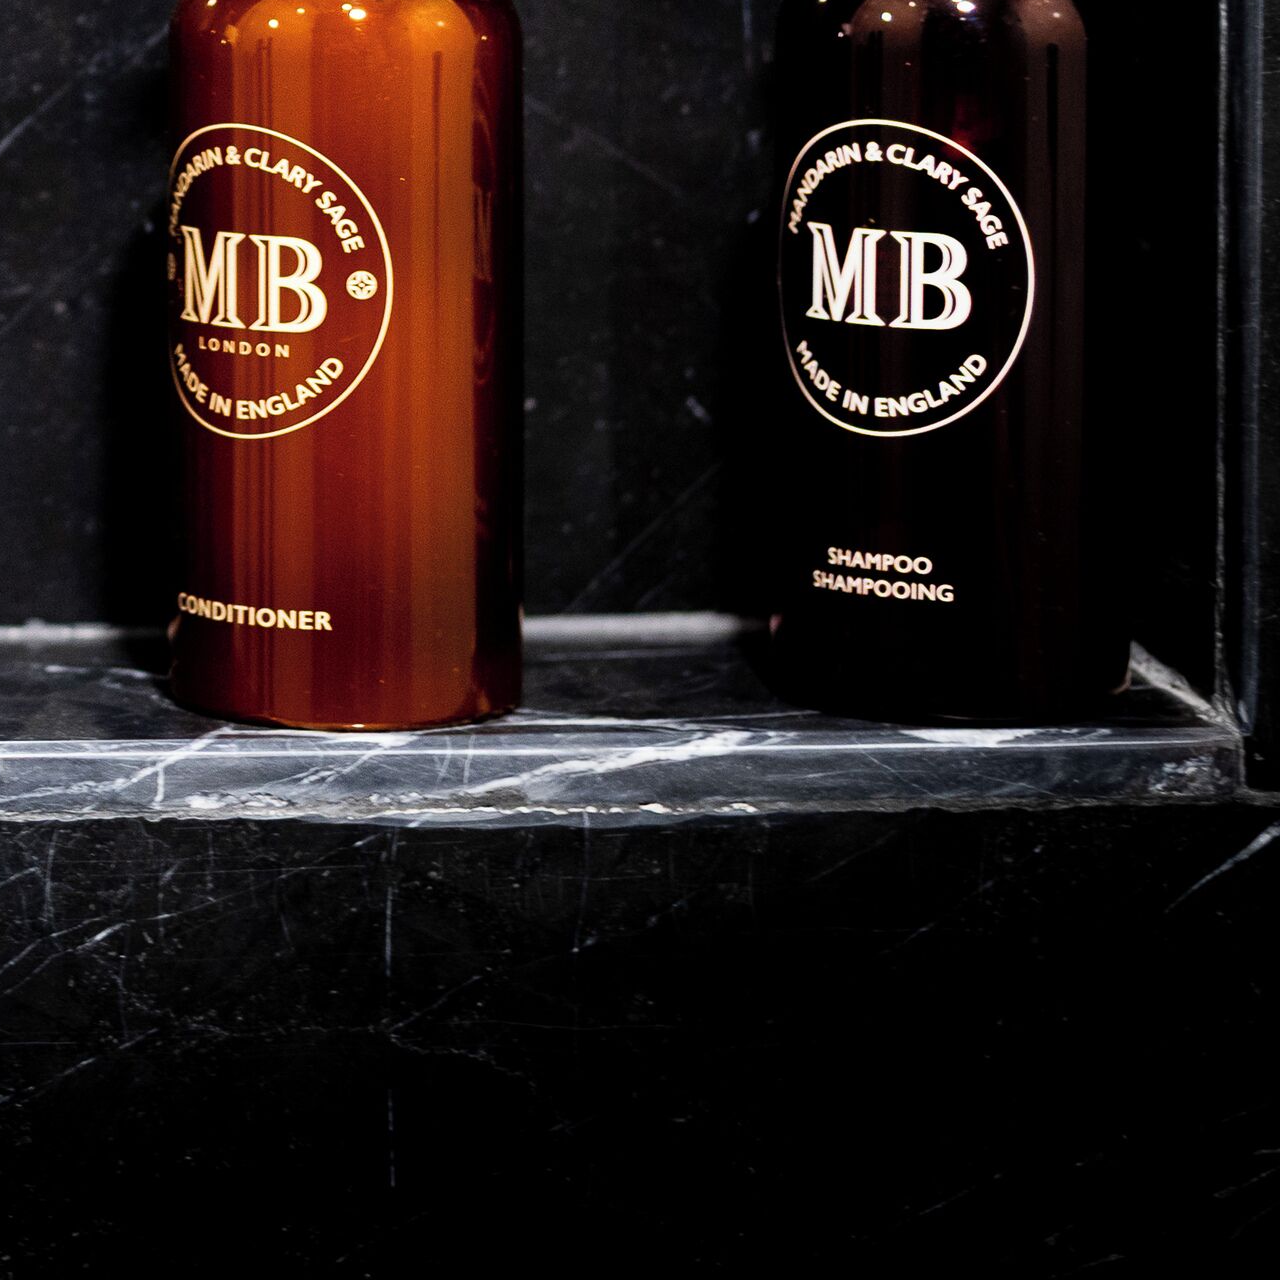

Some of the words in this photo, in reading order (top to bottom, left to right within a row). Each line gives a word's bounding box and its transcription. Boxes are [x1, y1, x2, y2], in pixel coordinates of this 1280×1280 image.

[225, 145, 241, 165] &
[244, 147, 323, 194] CLARY
[315, 191, 365, 254] SAGE
[865, 141, 883, 162] &
[886, 143, 969, 190] CLARY
[961, 187, 1009, 250] SAGE
[180, 224, 329, 334] MB
[805, 220, 972, 331] MB
[173, 342, 209, 405] MADE
[208, 392, 232, 417] IN
[236, 357, 345, 420] ENGLAND
[197, 335, 290, 358] LONDON
[795, 339, 842, 402] MADE
[841, 388, 869, 415] IN
[873, 353, 988, 418] ENGLAND
[813, 570, 954, 602] SHAMPOOING
[827, 547, 933, 575] SHAMPOO
[178, 592, 333, 631] CONDITIONER
